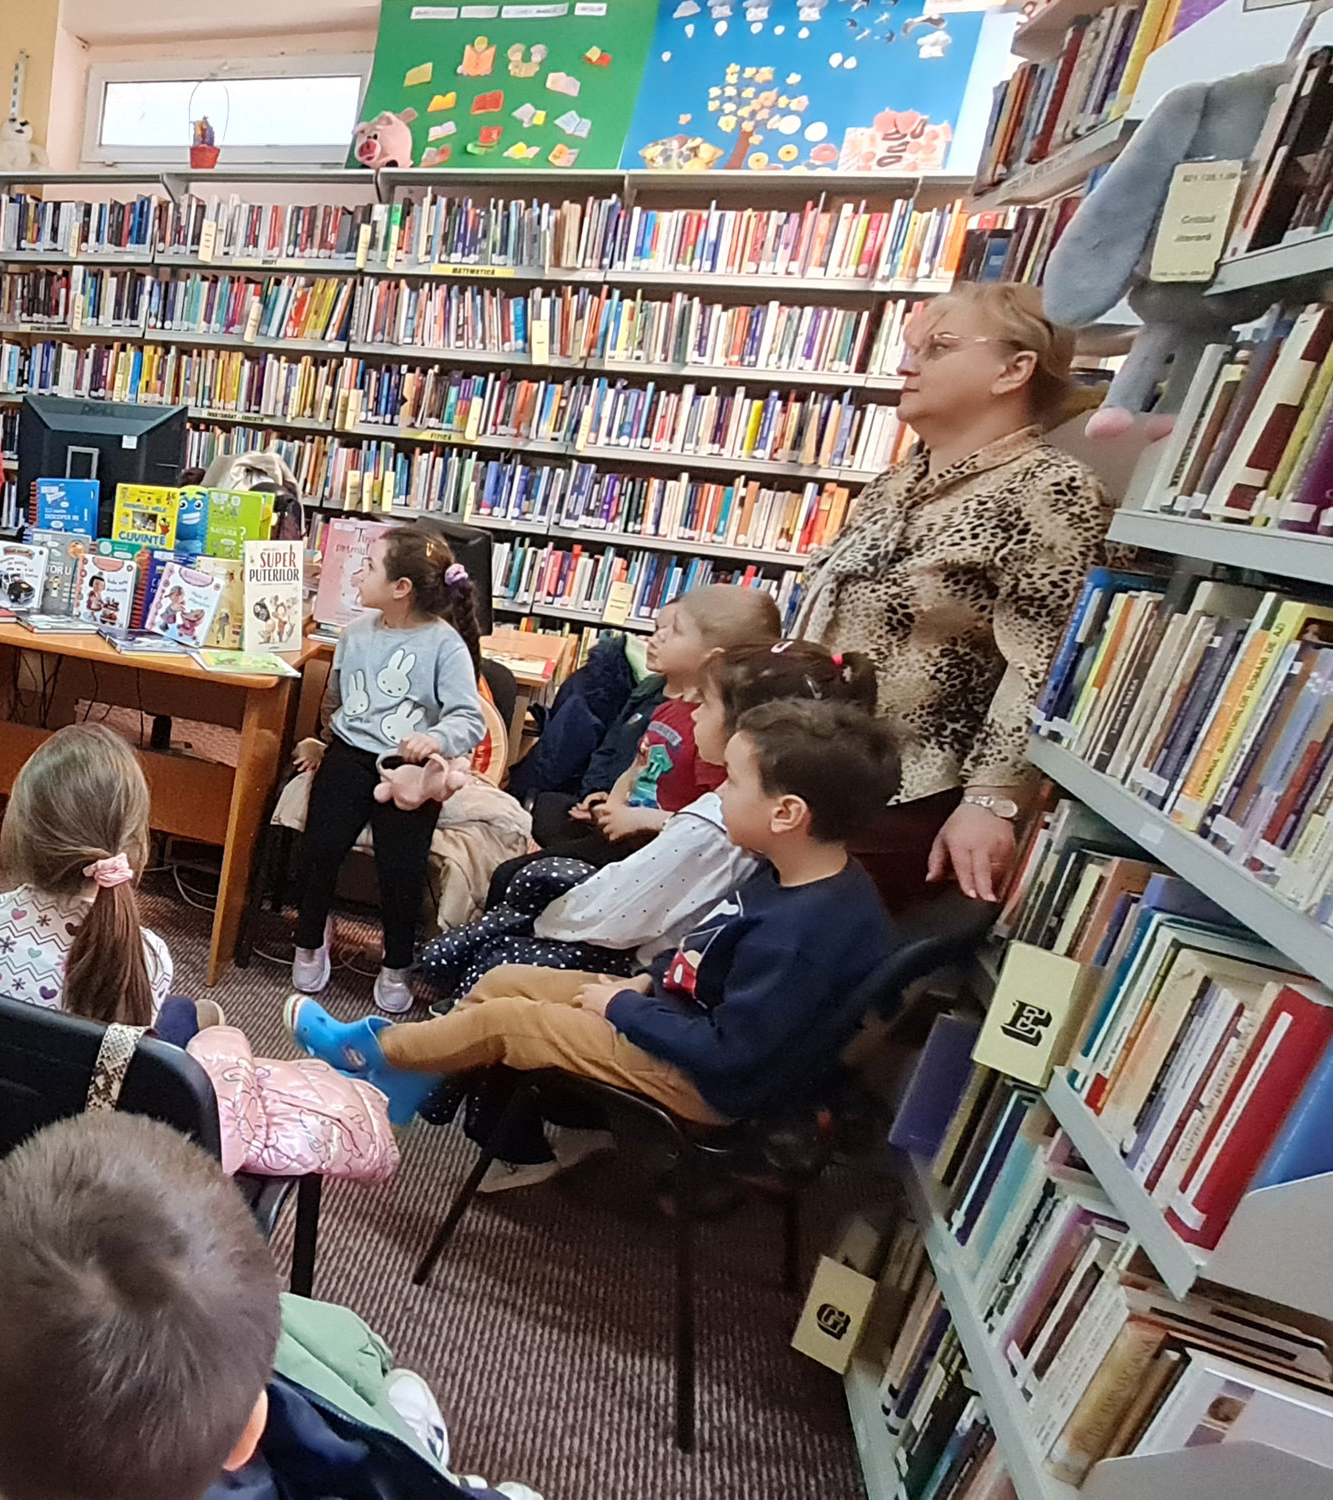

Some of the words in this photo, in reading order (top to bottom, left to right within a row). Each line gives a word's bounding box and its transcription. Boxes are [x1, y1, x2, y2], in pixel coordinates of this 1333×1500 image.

[260, 544, 296, 569] SUPER
[249, 568, 300, 582] PUTERILOR
[1001, 999, 1053, 1047] E
